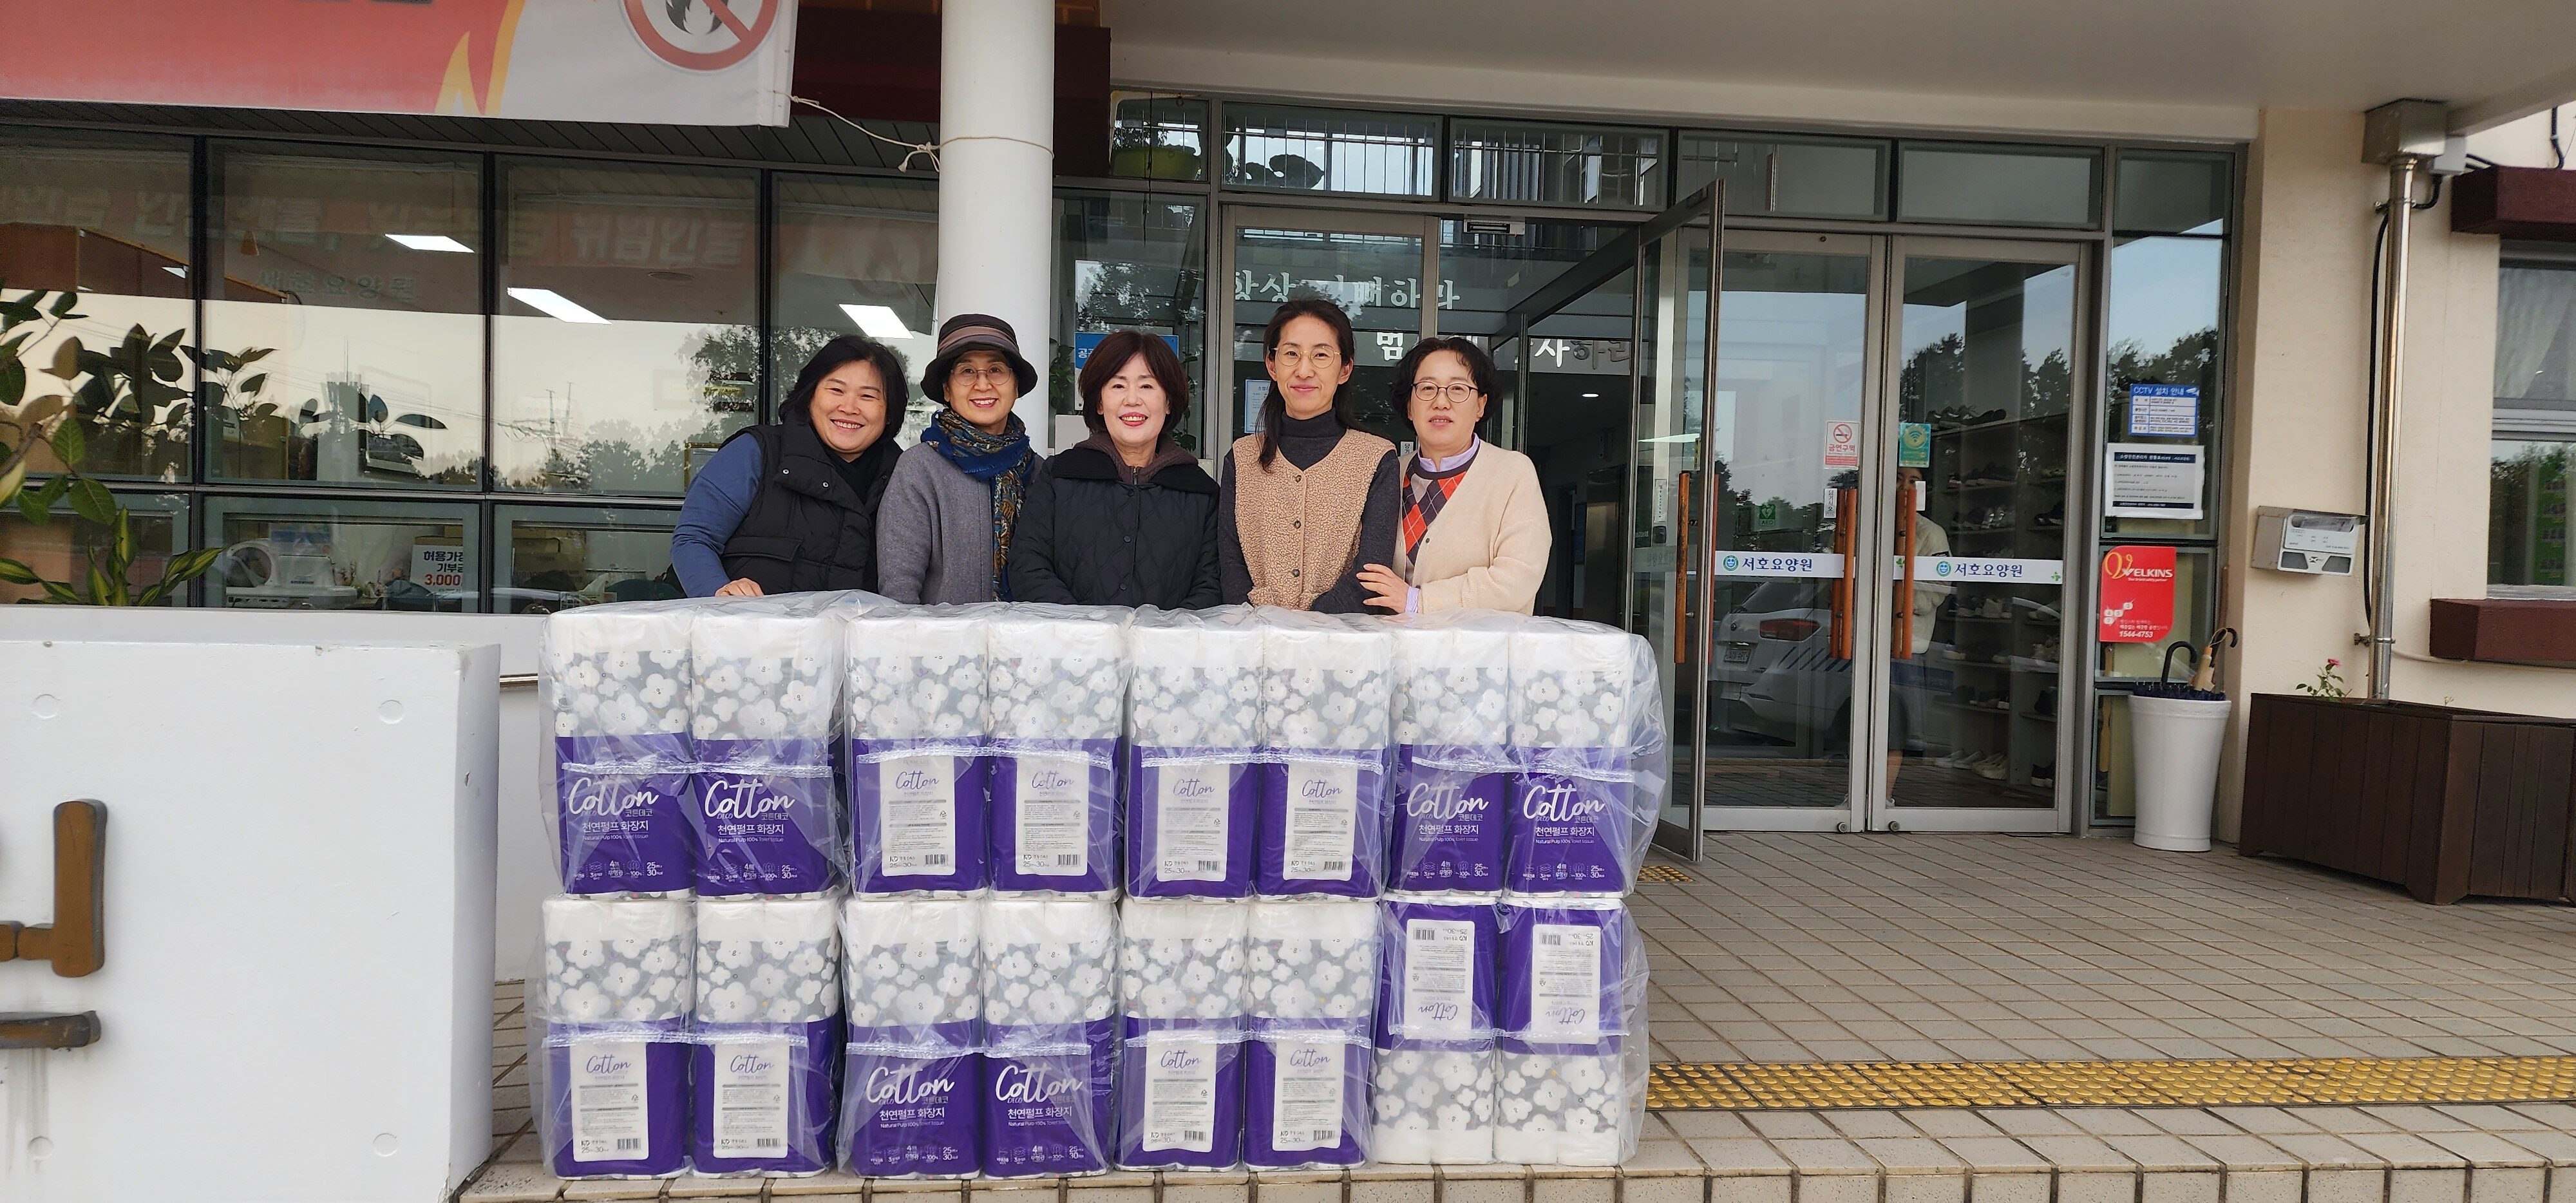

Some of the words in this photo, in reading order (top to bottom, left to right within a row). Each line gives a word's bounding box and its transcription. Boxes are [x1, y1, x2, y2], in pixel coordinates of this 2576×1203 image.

[1828, 444, 1855, 453] 금연구역
[1741, 557, 1813, 572] 서호요양원
[1954, 563, 2023, 577] 서호요양원
[896, 770, 940, 790] Cotton
[1032, 770, 1075, 790] Cotton
[1173, 779, 1215, 797] Cotton
[1302, 779, 1343, 798] Cotton
[569, 777, 659, 817] Cotton
[705, 778, 795, 819] Cotton
[1407, 781, 1489, 819] Cotton
[1524, 783, 1605, 822] Cotton
[625, 809, 653, 817] 코튼데코
[582, 821, 620, 833] 천연펄프
[621, 820, 649, 831] 화장지
[717, 824, 755, 835] 천연펄프
[757, 824, 784, 834] 화장지
[1419, 824, 1453, 834] 천연펄프
[1454, 824, 1479, 834] 화장지
[1535, 827, 1569, 837] 천연펄프
[1569, 827, 1595, 837] 화장지
[1417, 1002, 1458, 1021] Cotton
[587, 1054, 630, 1074] Cotton
[730, 1054, 774, 1074] Cotton
[1161, 1050, 1202, 1068] Cotton
[1290, 1049, 1331, 1067] Cotton
[866, 1064, 954, 1104] Cotton
[996, 1062, 1083, 1103] Cotton
[879, 1109, 916, 1121] 천연펄프
[917, 1106, 945, 1118] 화장지
[1007, 1108, 1044, 1119] 천연펄프
[1045, 1106, 1072, 1118] 화장지
